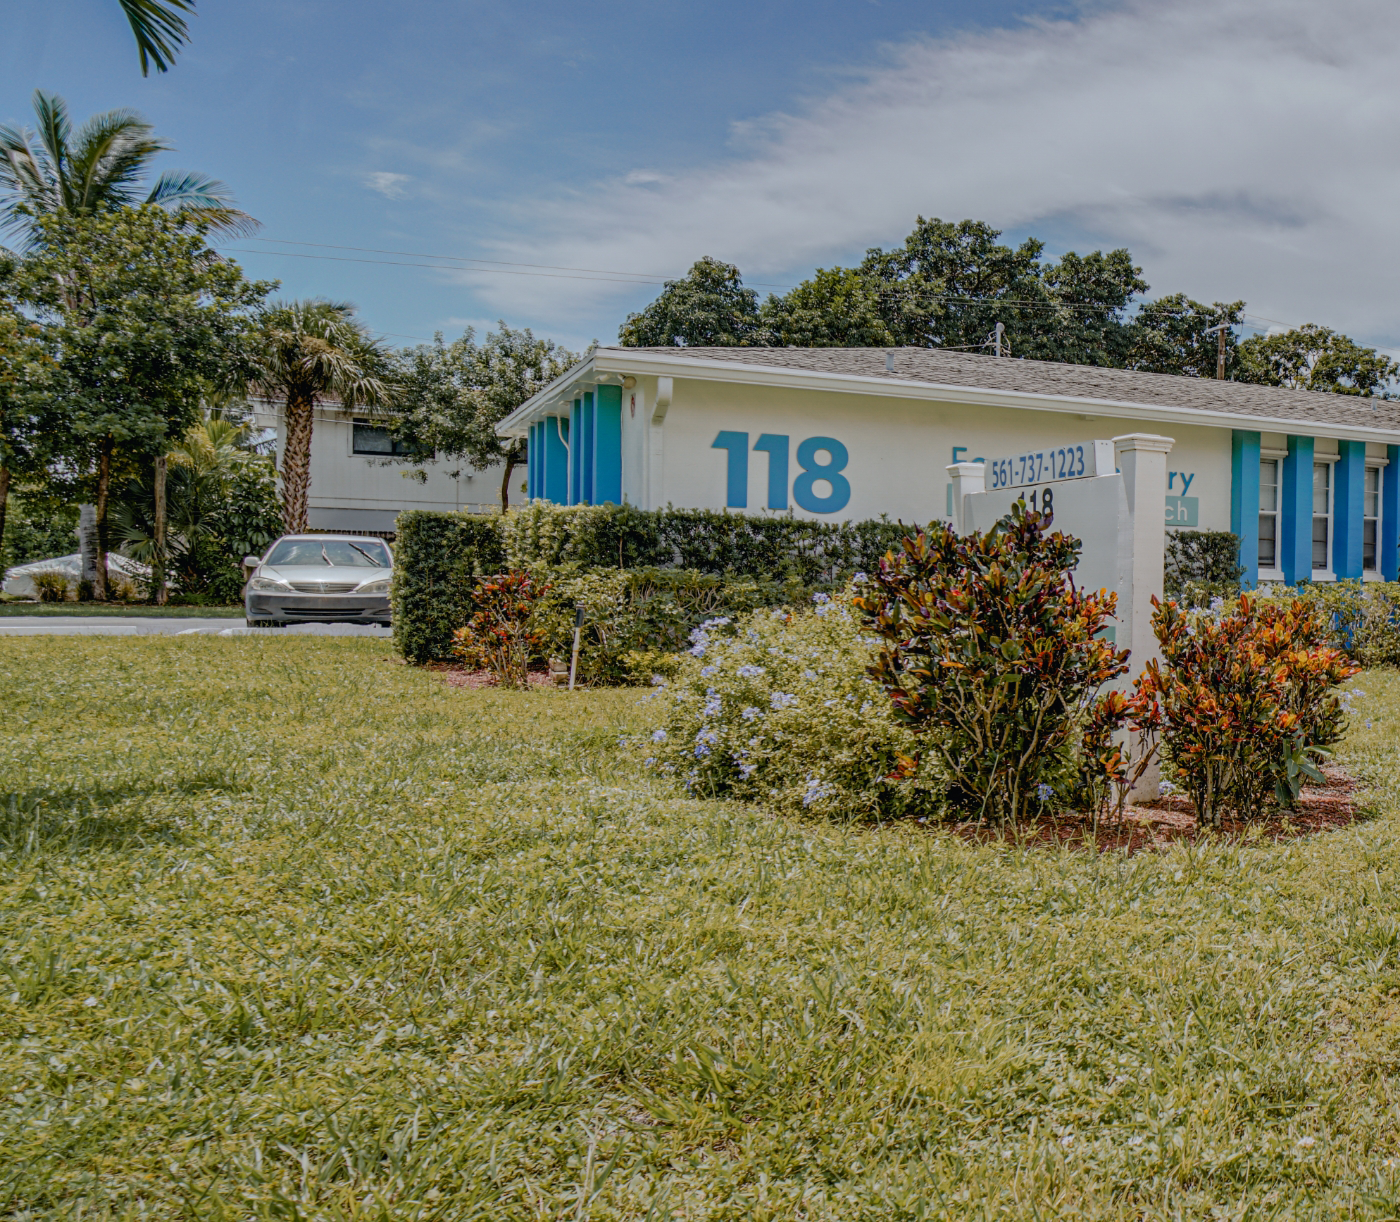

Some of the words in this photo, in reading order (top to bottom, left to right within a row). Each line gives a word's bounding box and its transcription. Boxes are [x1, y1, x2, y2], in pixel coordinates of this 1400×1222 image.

[711, 431, 851, 514] 118
[992, 446, 1085, 488] 561-737-1223
[1018, 488, 1054, 519] 18
